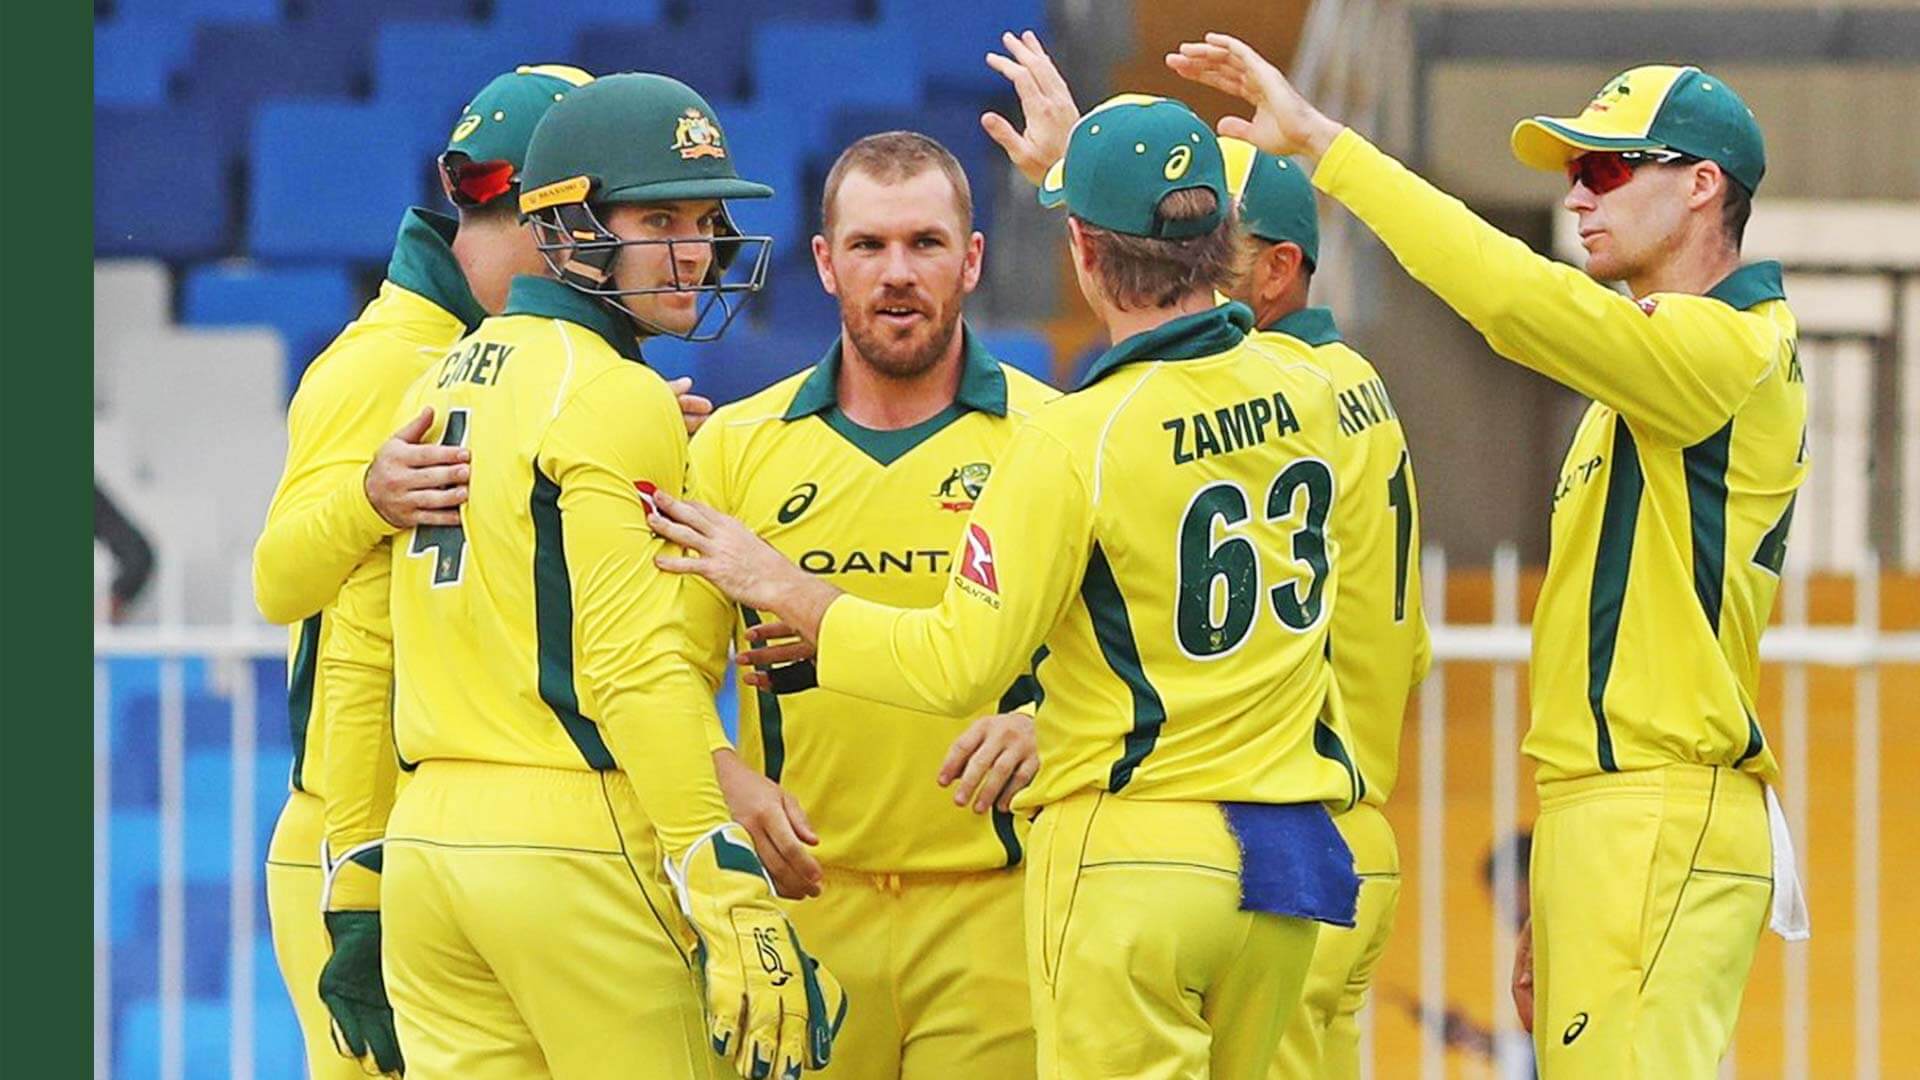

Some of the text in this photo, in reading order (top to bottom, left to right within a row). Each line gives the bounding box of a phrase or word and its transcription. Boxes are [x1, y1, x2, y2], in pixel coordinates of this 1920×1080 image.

[1162, 391, 1300, 465] ZAMPA
[799, 550, 954, 575] QANT
[1176, 456, 1335, 662] 63
[953, 575, 1001, 610] QANTAS
